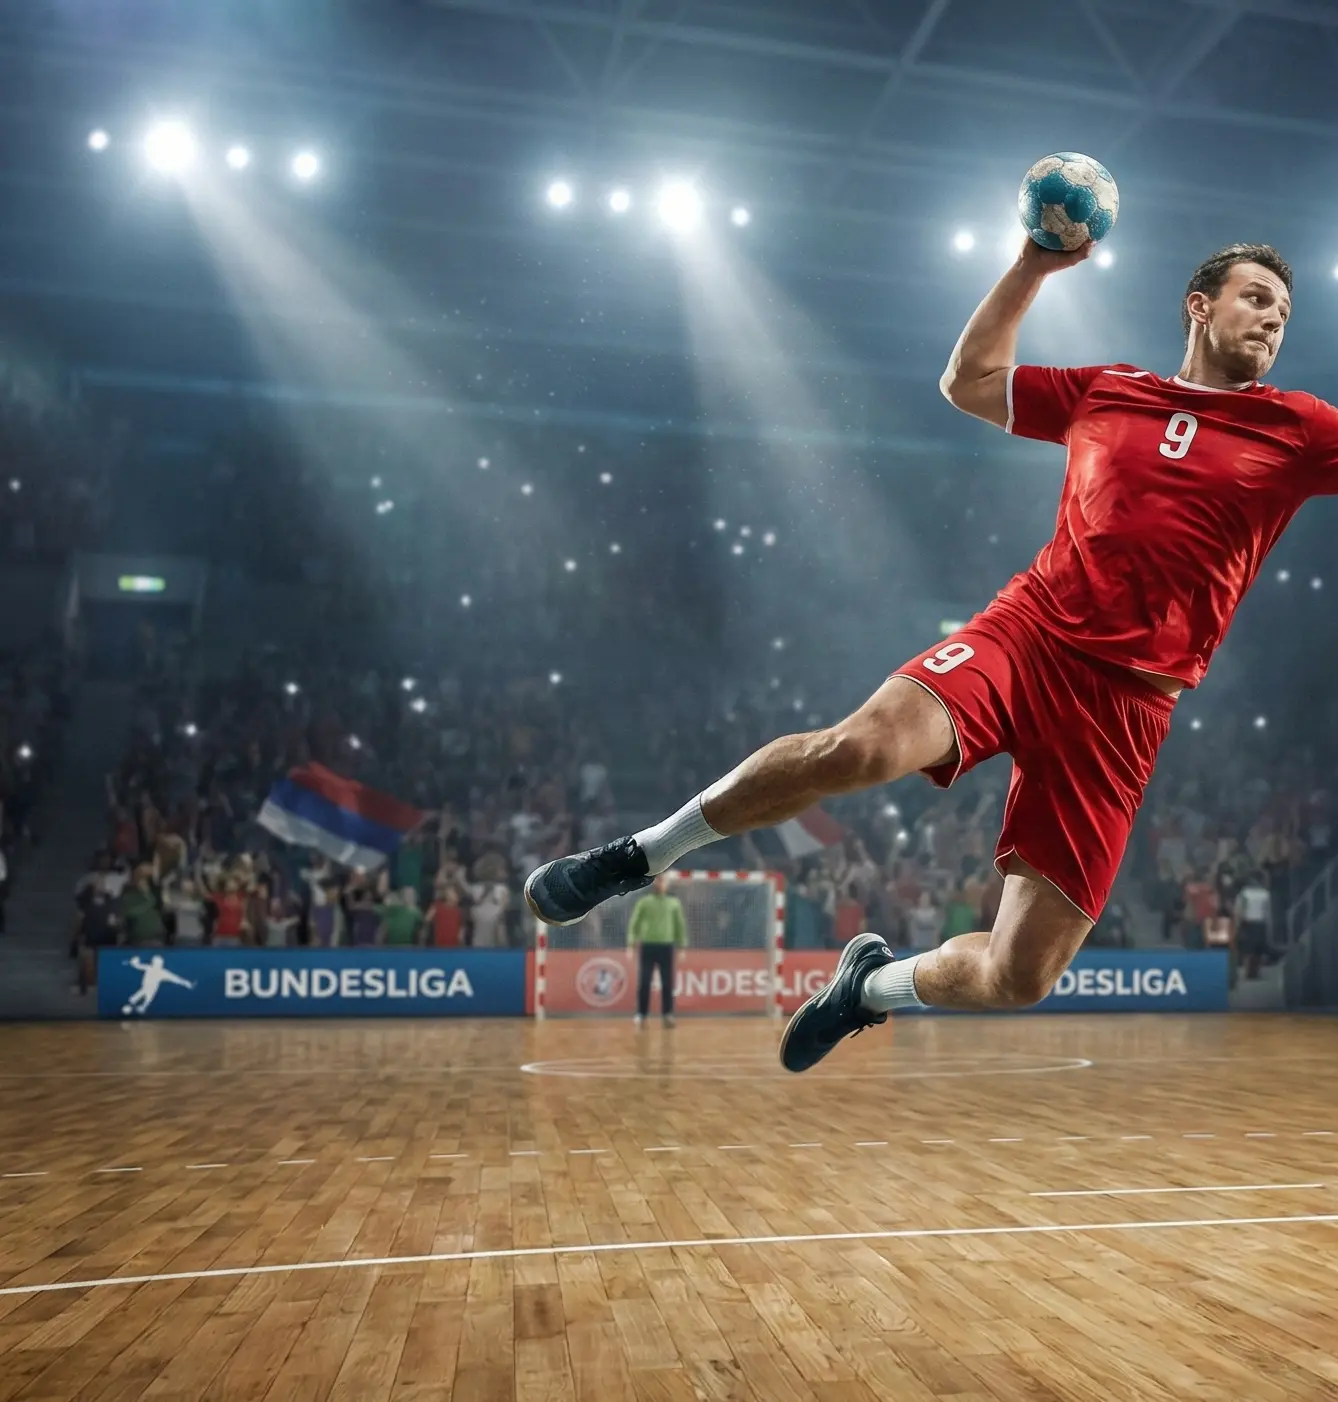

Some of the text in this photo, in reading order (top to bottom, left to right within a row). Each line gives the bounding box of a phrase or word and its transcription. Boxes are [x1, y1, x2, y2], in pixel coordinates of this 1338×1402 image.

[1159, 412, 1198, 459] 9
[922, 642, 975, 674] 9
[224, 968, 474, 998] BUNDESLIGA
[1054, 968, 1187, 996] DESLIGA
